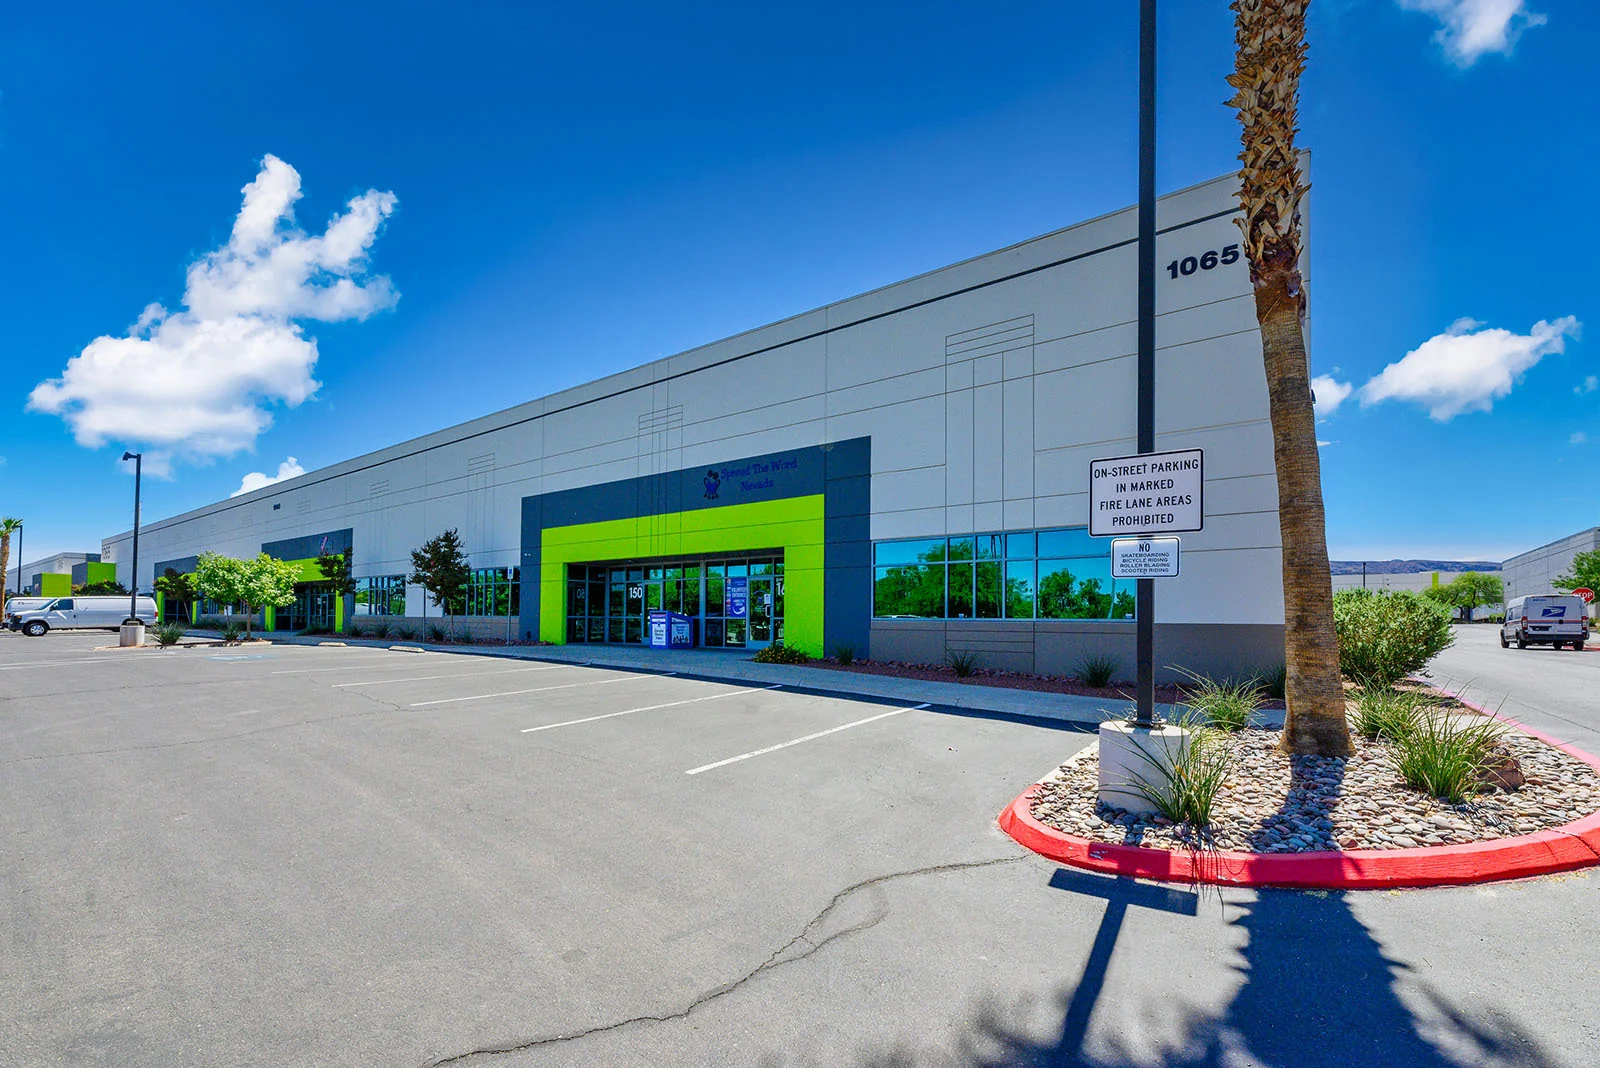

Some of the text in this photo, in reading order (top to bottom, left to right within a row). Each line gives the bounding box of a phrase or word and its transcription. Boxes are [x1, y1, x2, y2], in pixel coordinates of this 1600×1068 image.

[1166, 243, 1240, 280] 1065
[720, 457, 798, 481] Spread The Word
[1094, 459, 1199, 479] ON-STREET PARKING
[740, 477, 775, 492] Nevada
[1116, 479, 1174, 493] IN MARKED
[1100, 494, 1192, 511] FIRE LANE AREAS
[1112, 513, 1174, 526] PROHIBITED
[1138, 543, 1150, 552] NO
[628, 587, 643, 599] 150
